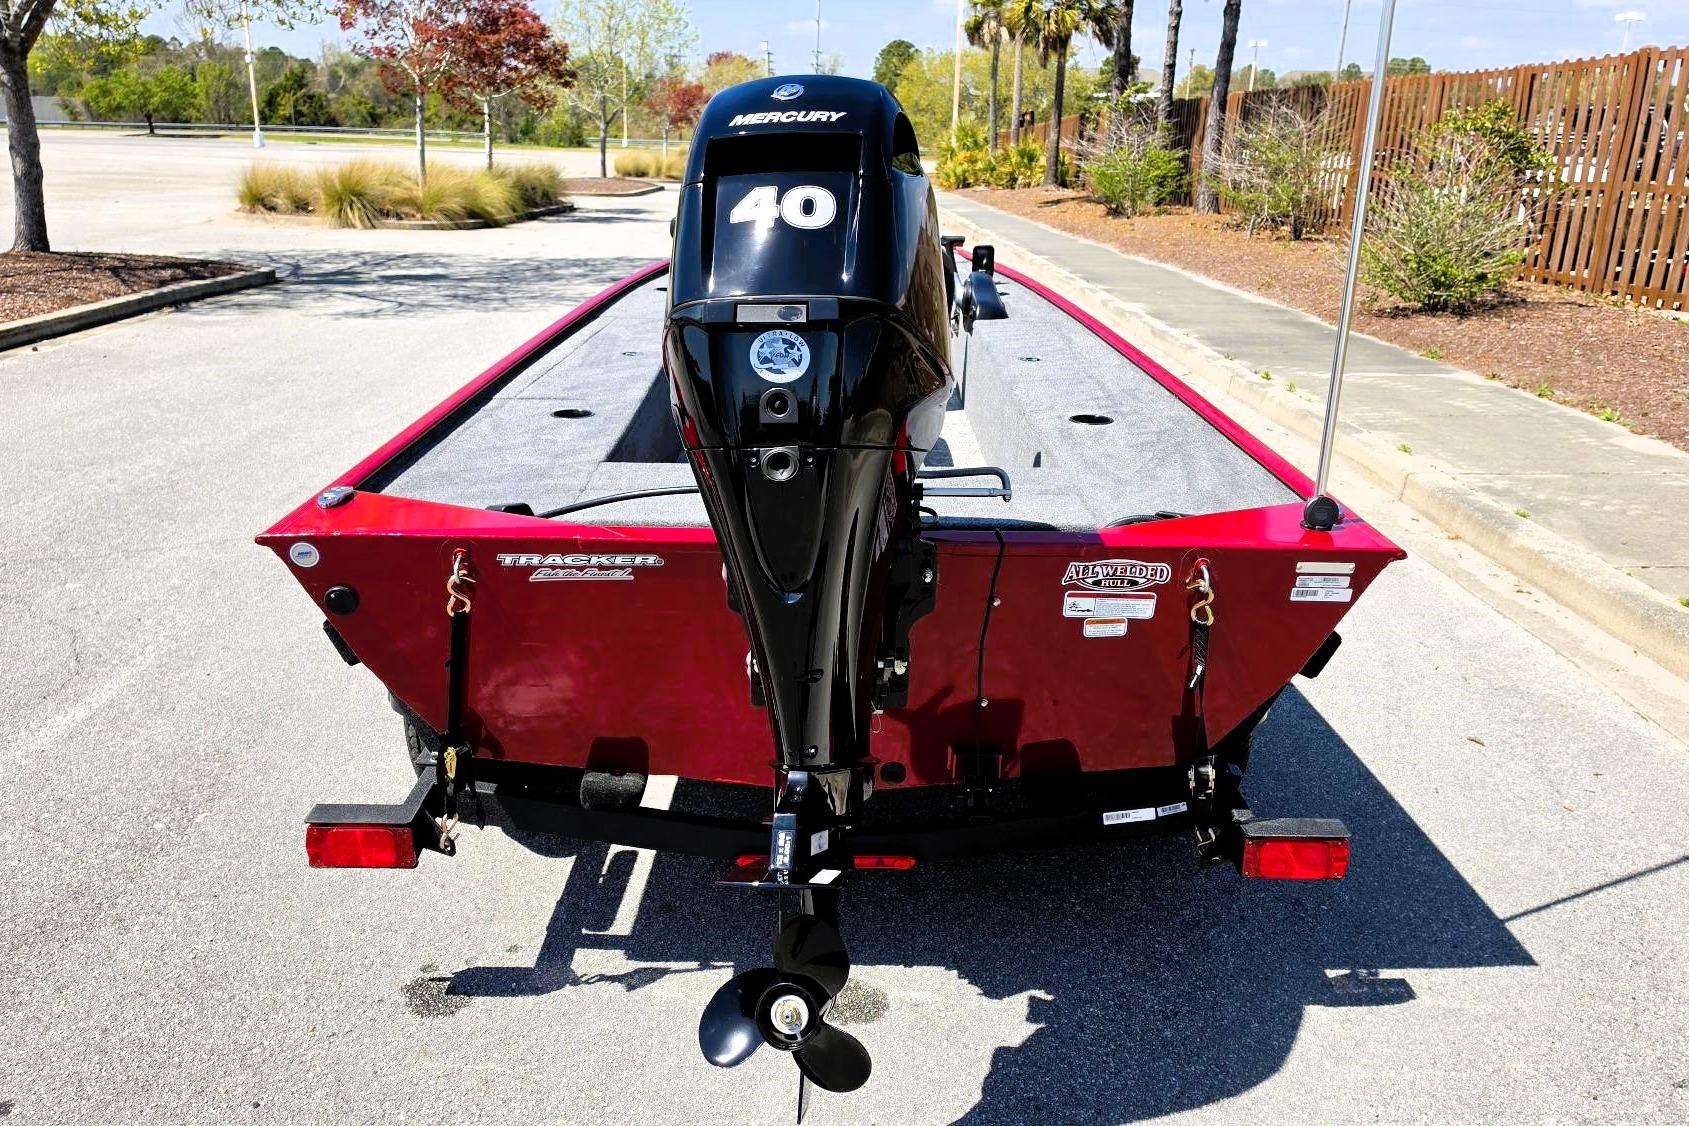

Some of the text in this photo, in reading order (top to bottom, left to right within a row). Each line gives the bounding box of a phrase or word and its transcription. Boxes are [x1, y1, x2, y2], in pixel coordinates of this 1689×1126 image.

[728, 110, 847, 127] MERCURY
[729, 185, 837, 229] 40
[1067, 563, 1169, 581] ALL WELDED
[1101, 579, 1131, 587] HULL
